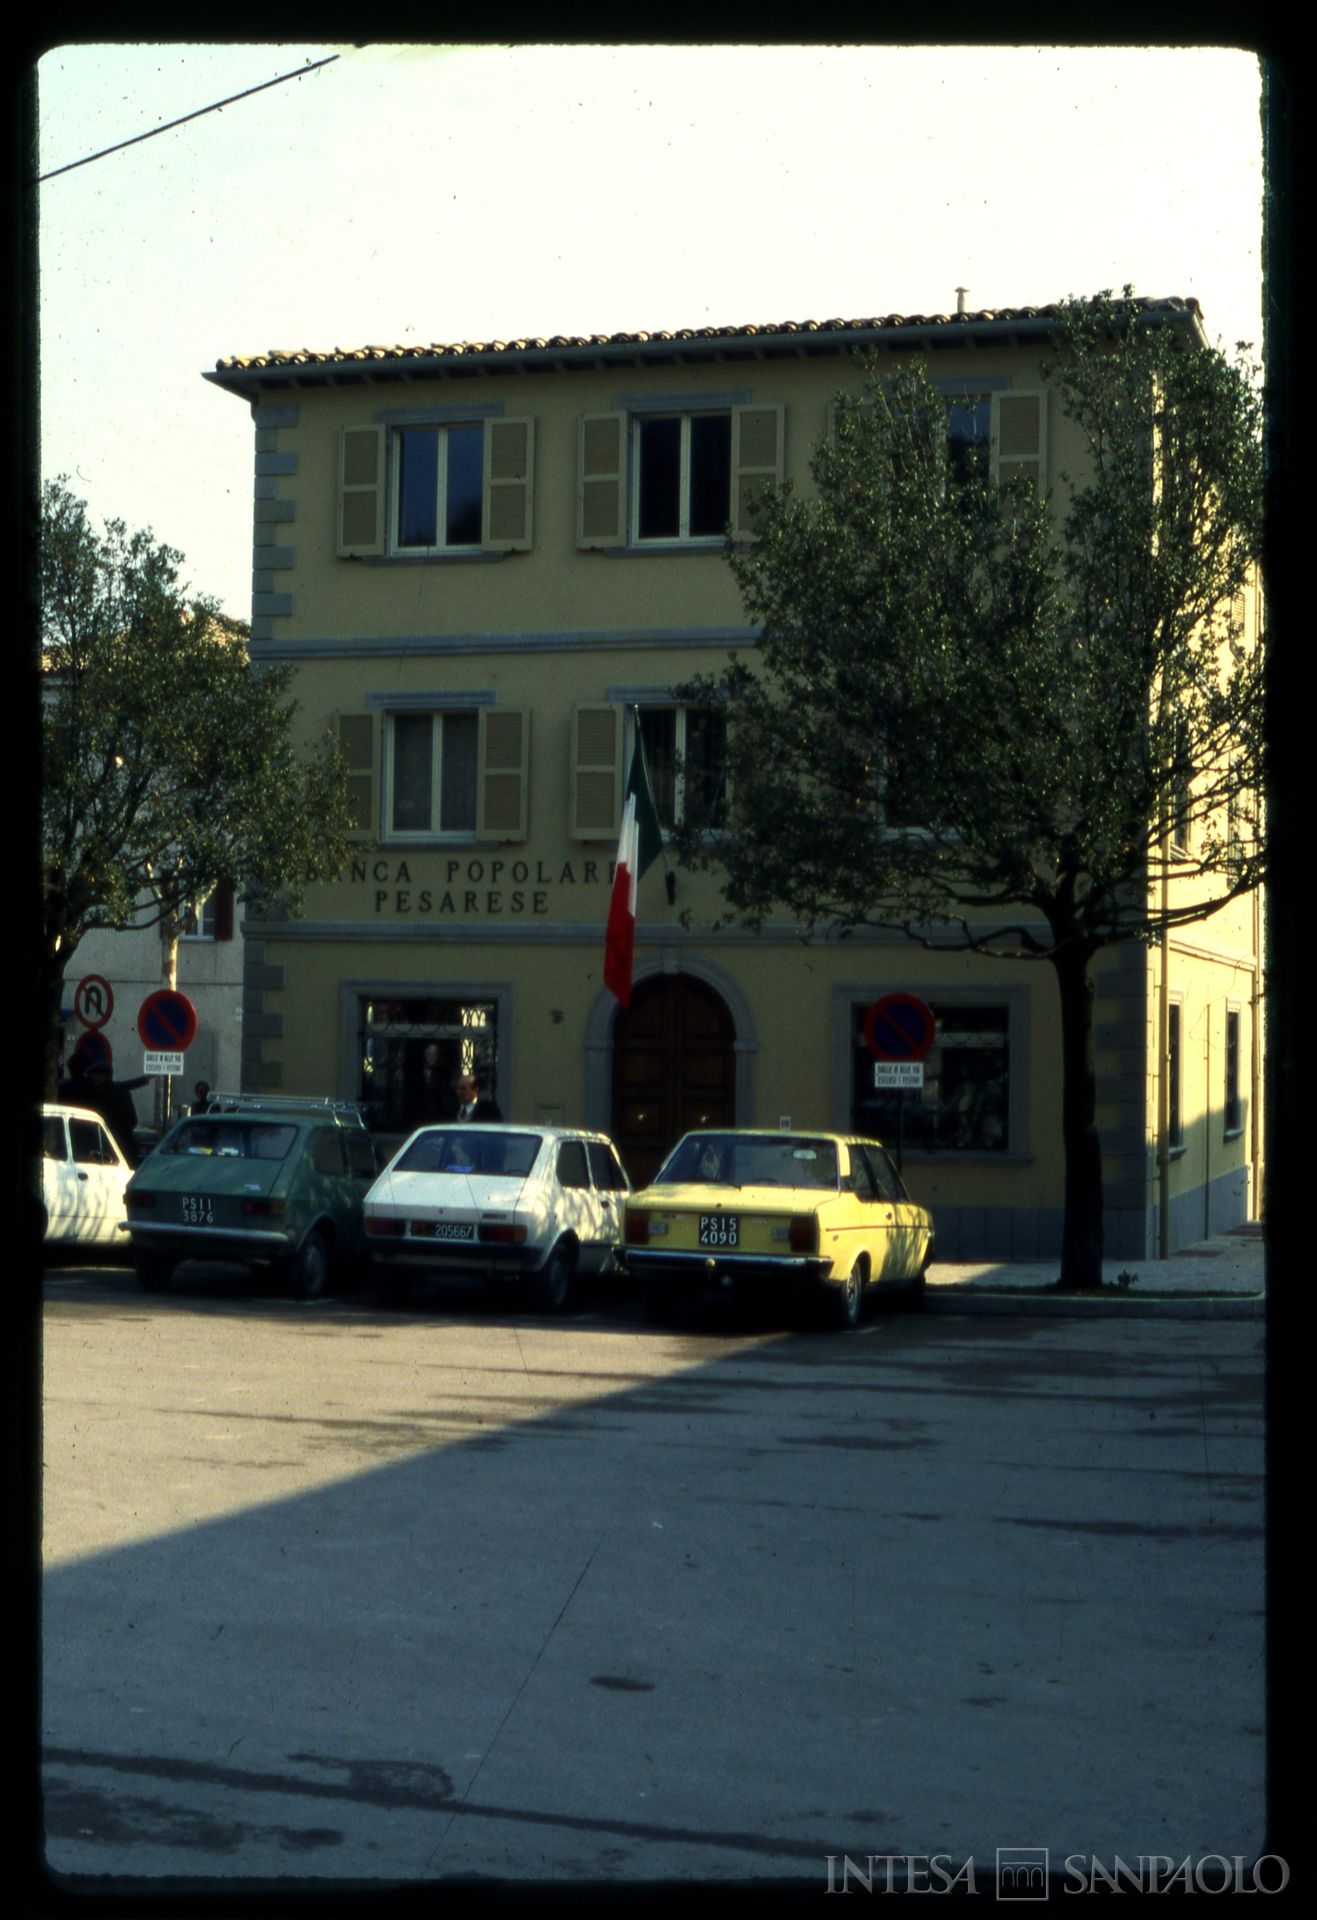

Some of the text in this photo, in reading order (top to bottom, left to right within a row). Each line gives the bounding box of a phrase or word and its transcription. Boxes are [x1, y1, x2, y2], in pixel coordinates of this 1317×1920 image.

[374, 891, 549, 913] PESARESE
[183, 1210, 214, 1223] 3876
[701, 1216, 737, 1231] PS15
[435, 1223, 473, 1238] 205667
[701, 1231, 737, 1245] 4090
